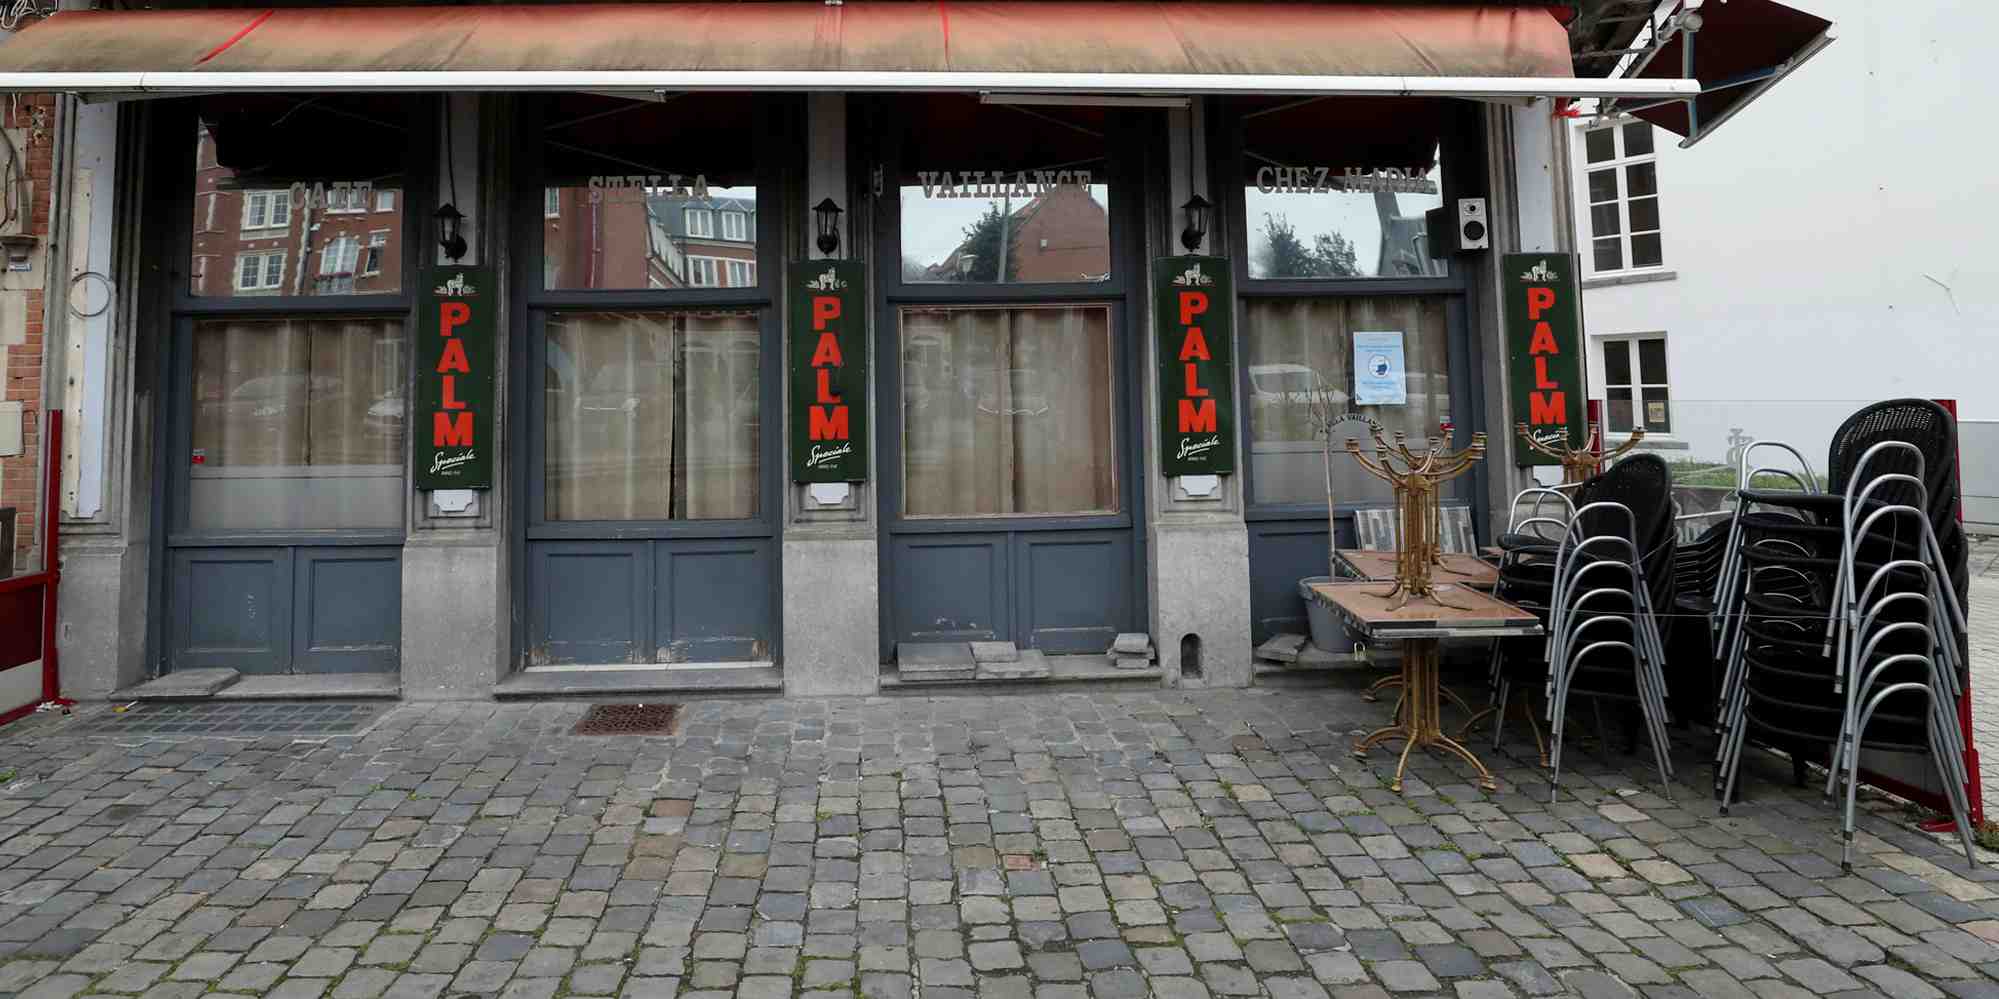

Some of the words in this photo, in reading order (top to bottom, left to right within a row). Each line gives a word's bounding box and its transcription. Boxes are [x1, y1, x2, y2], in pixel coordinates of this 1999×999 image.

[588, 174, 712, 201] STELLA
[917, 170, 1094, 199] VAILLANCE
[1256, 167, 1329, 194] CHEZ
[434, 302, 474, 447] PALM
[809, 296, 849, 440] PALM
[1178, 292, 1217, 433] PALM
[1527, 287, 1567, 425] PALM
